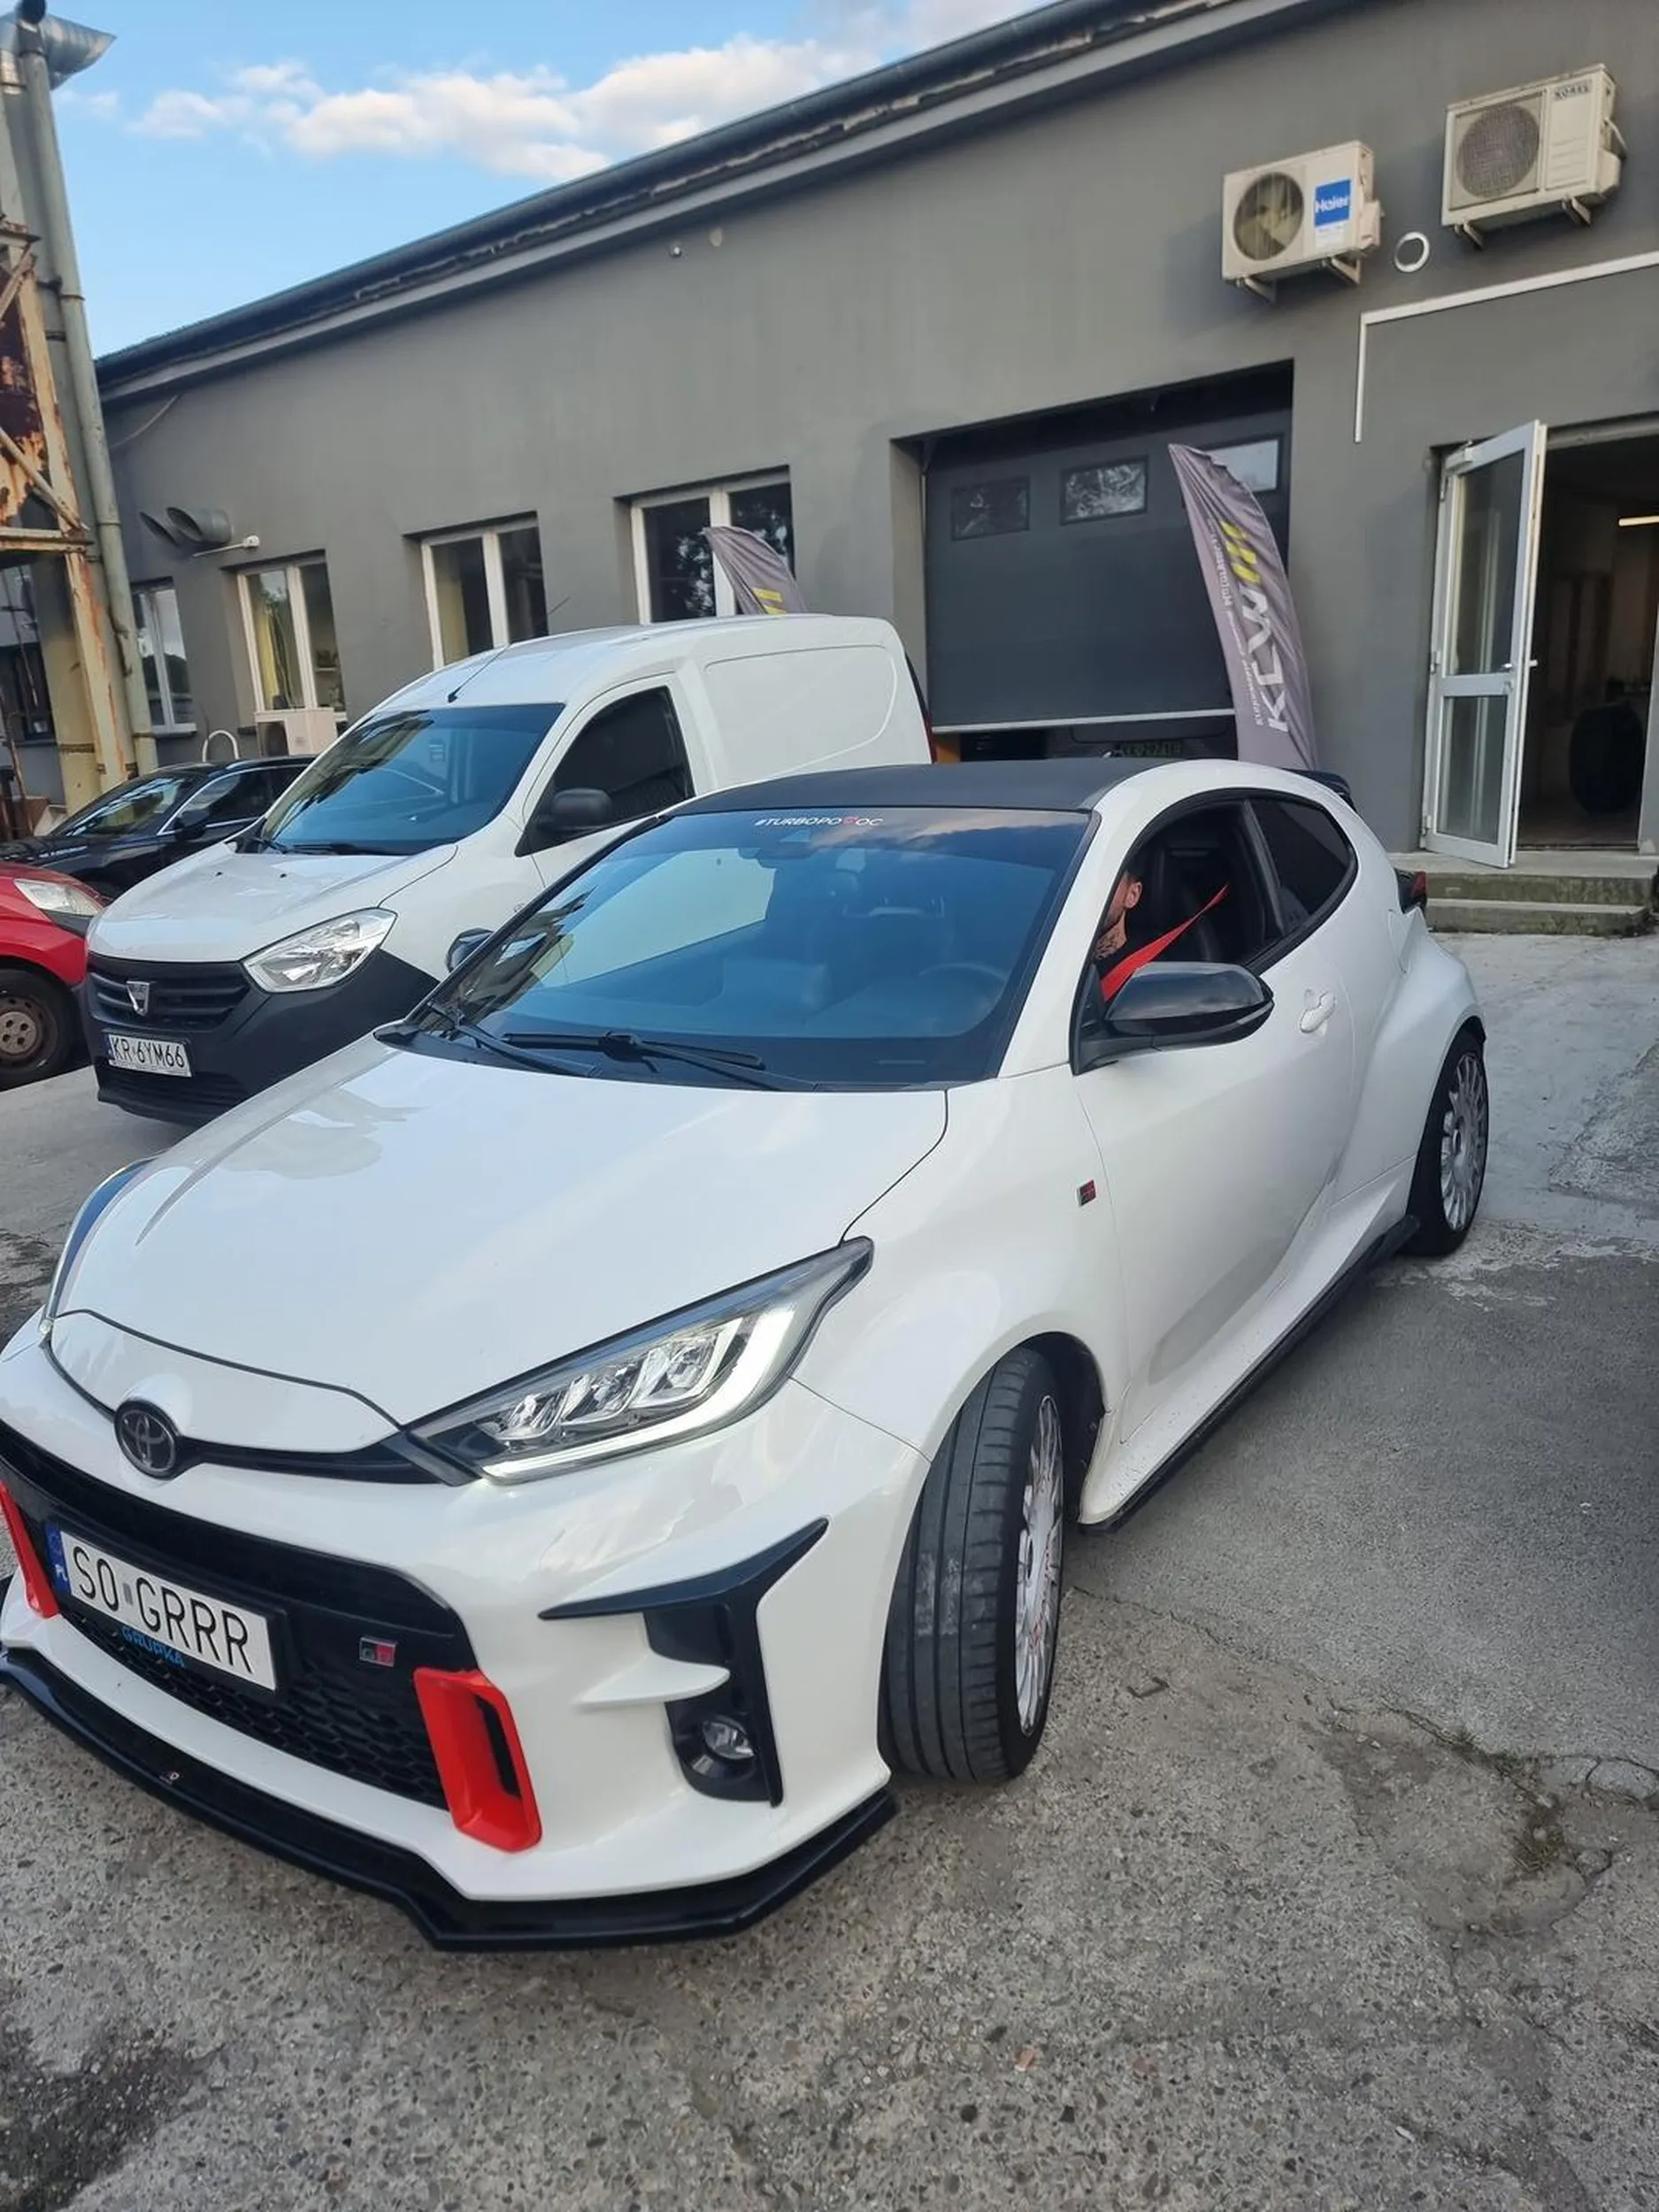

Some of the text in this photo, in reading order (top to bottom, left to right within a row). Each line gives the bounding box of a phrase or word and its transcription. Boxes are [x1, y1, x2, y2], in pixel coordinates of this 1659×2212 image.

[111, 1038, 185, 1068] KR 6YM66
[135, 1577, 253, 1674] GRRR
